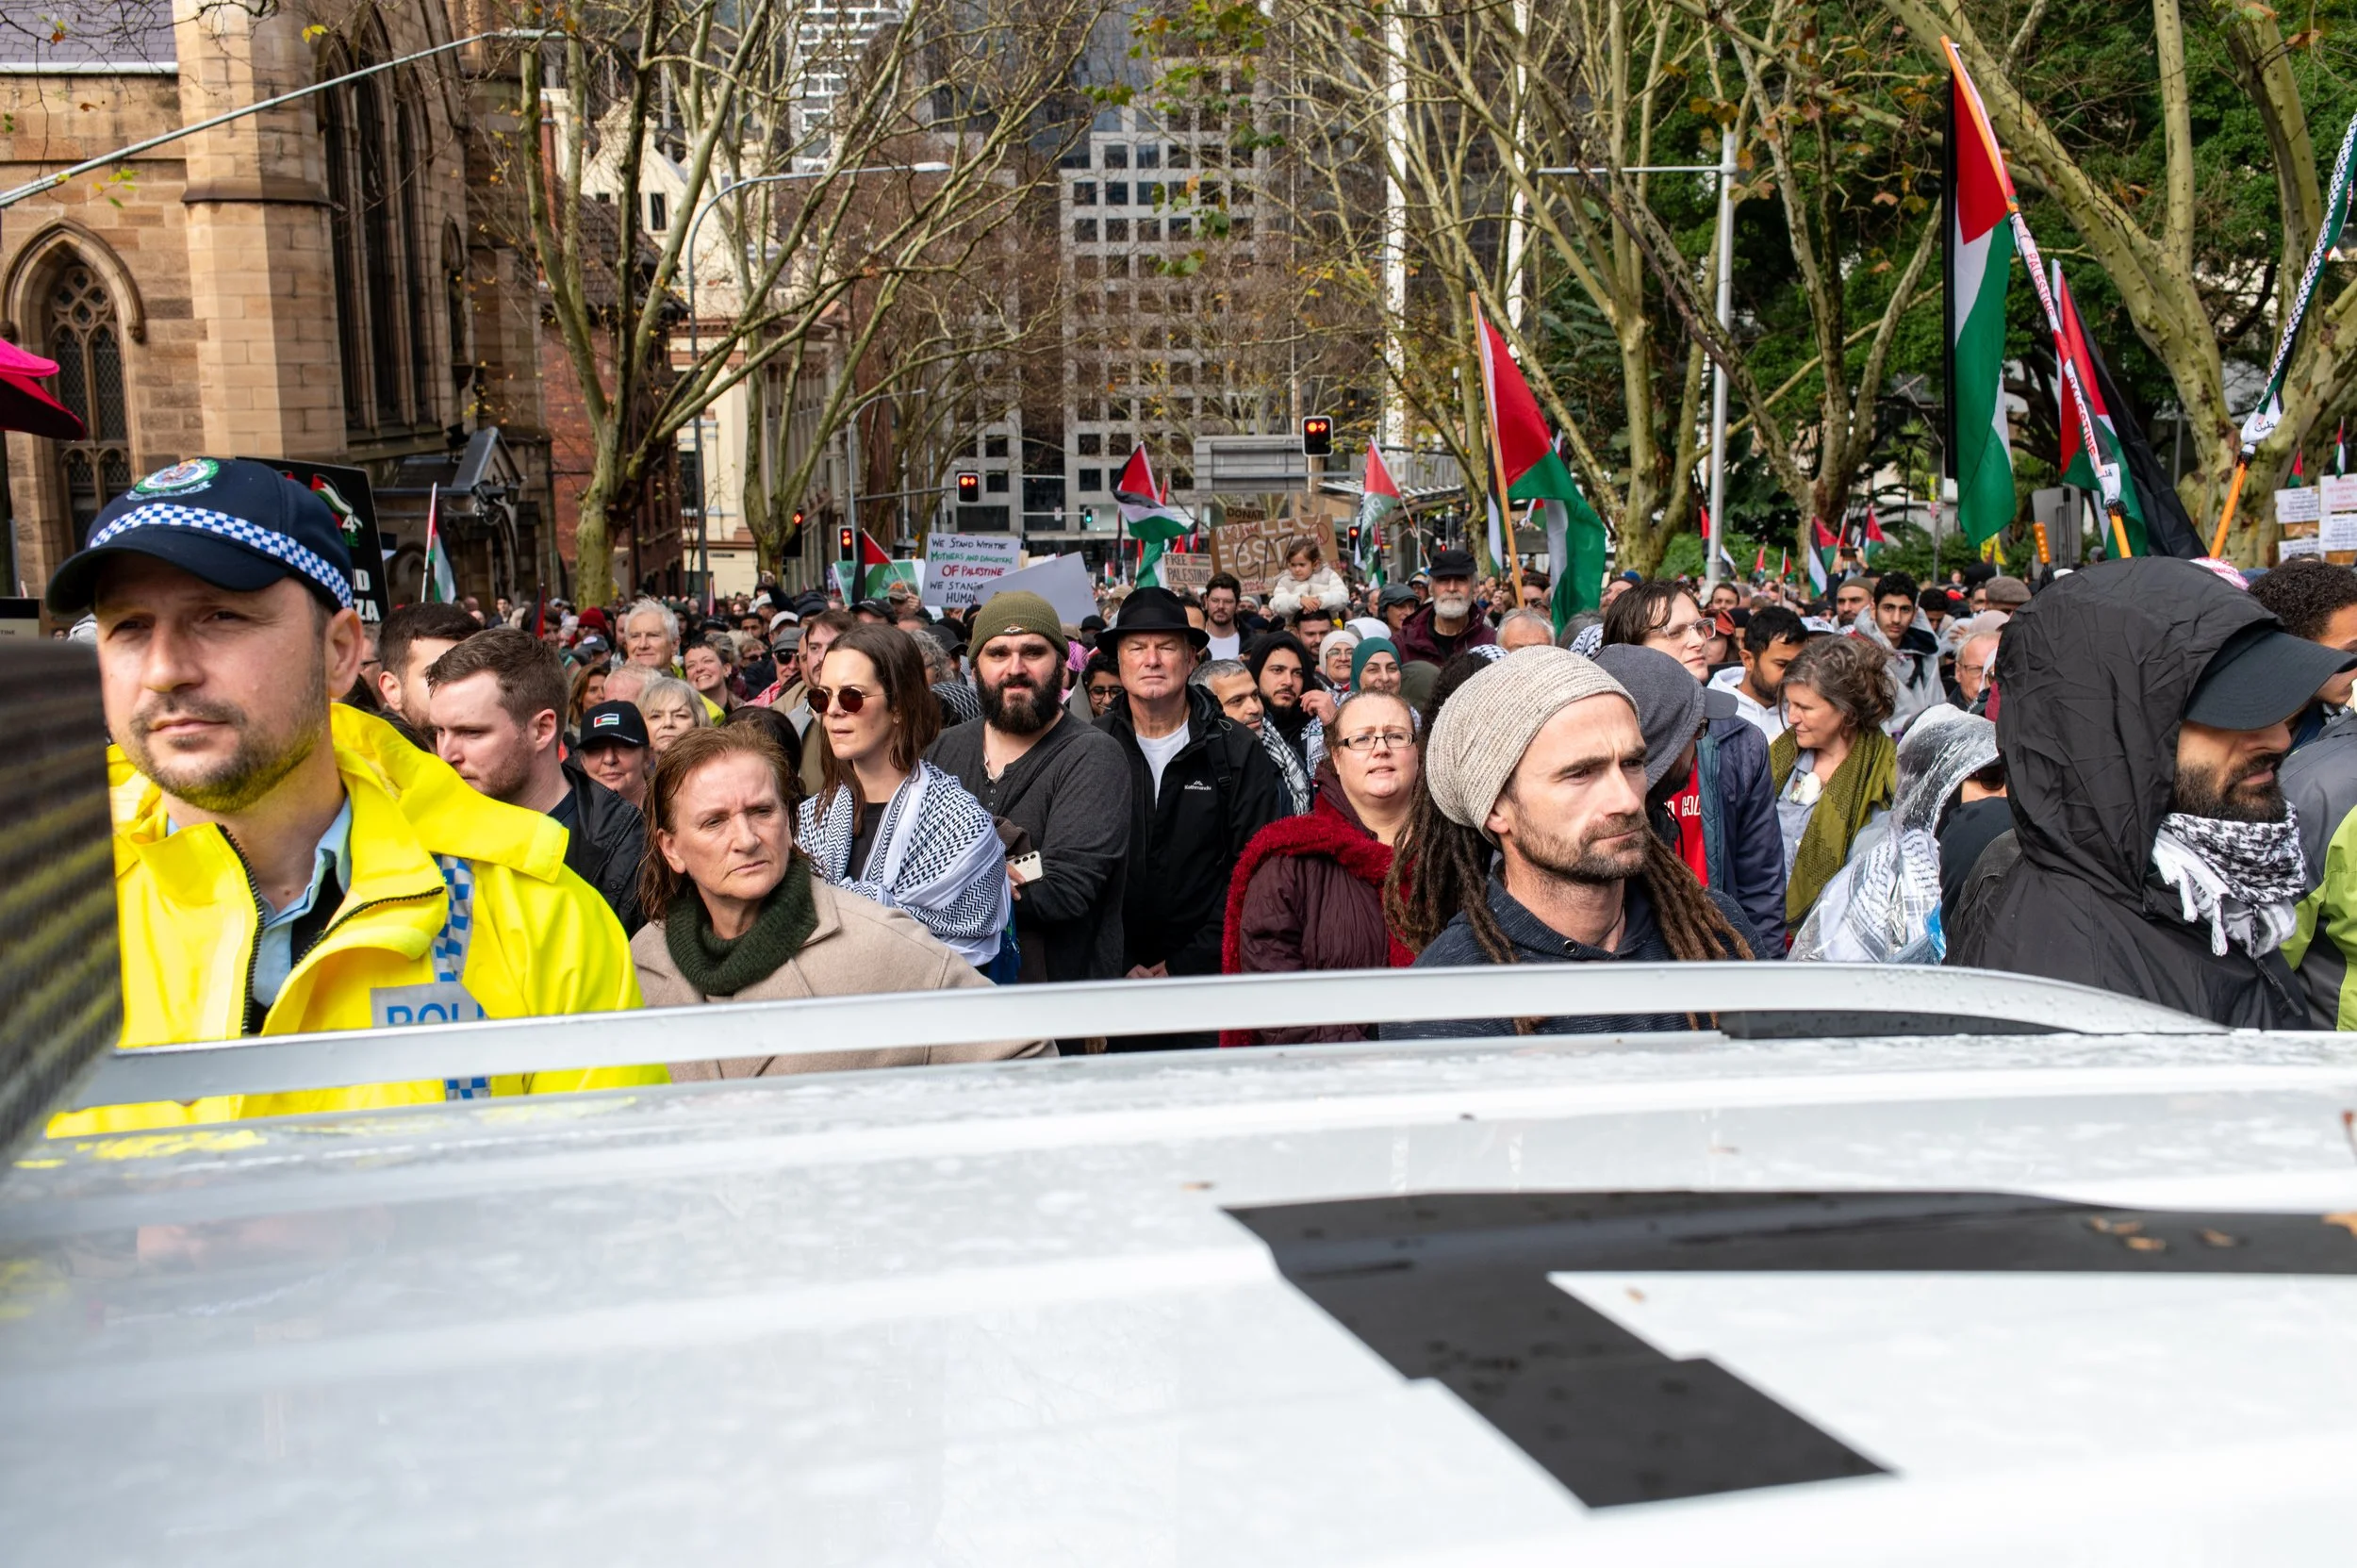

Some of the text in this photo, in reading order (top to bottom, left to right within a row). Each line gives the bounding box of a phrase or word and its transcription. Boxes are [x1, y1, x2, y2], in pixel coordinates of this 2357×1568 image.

[2026, 253, 2054, 317] PALESTINE
[1227, 506, 1265, 520] DONATE
[931, 538, 945, 548] WE
[949, 537, 974, 548] STAND
[931, 551, 964, 562] MOTHERS
[1164, 554, 1188, 565] FREE
[1236, 533, 1301, 584] GAZ
[942, 565, 1005, 577] OF PALESTINE
[1166, 568, 1211, 582] PALESTINE
[930, 581, 977, 590] WE STAN
